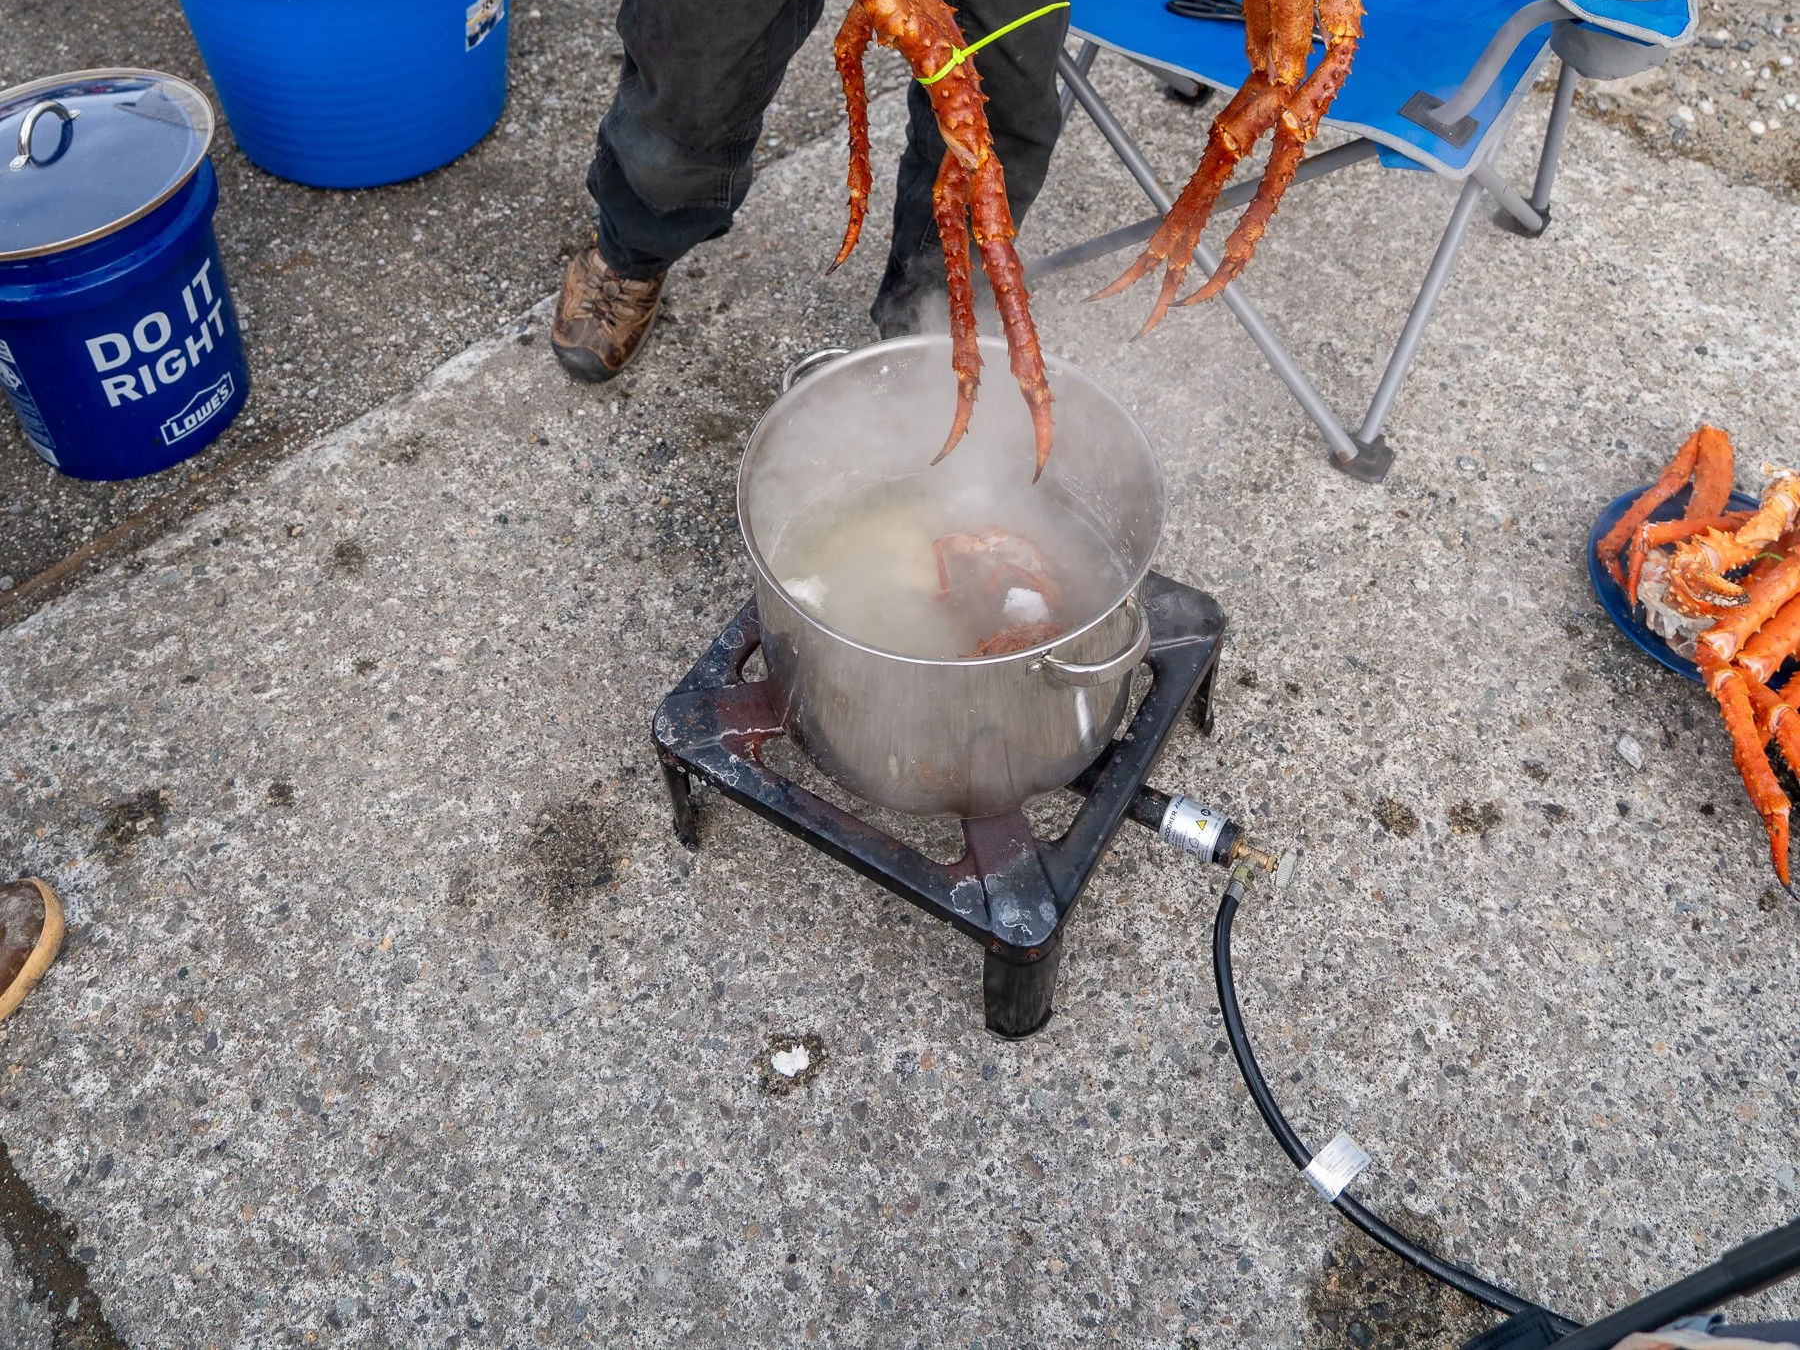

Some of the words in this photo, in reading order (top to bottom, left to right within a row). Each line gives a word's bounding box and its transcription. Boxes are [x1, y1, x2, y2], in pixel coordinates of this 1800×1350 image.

[85, 311, 171, 372] DO
[181, 257, 214, 324] IT
[101, 298, 225, 408] RIGHT
[170, 382, 230, 438] LOWE'S
